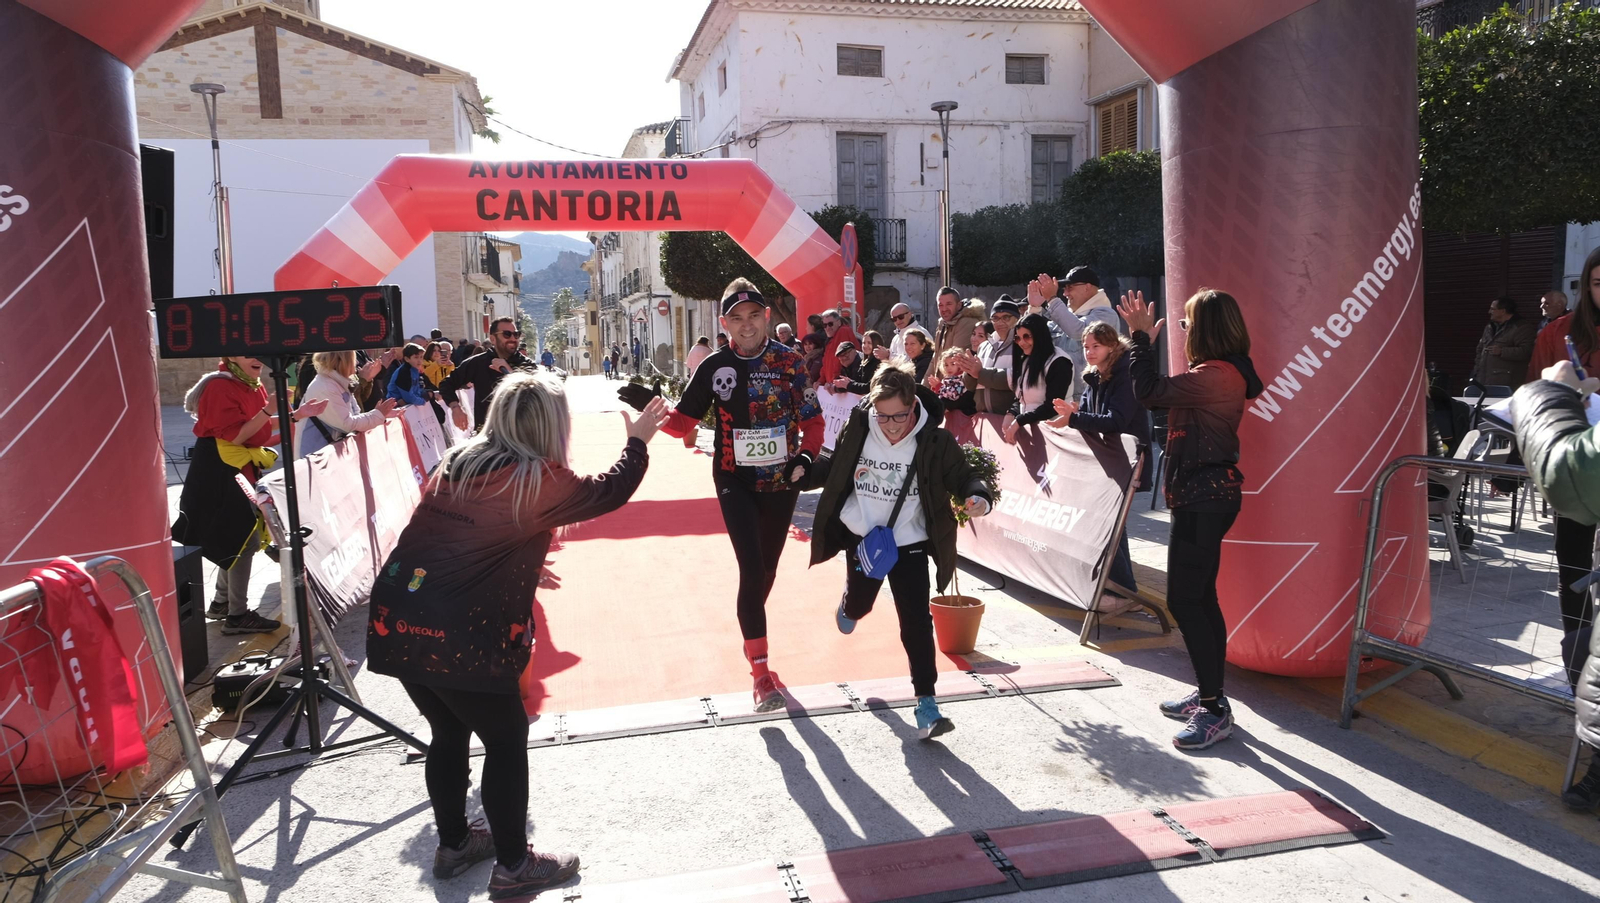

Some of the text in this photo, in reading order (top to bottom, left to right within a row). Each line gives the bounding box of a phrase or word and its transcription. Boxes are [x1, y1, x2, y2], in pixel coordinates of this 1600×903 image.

[468, 161, 688, 180] AYUNTAMIENTO
[476, 188, 682, 221] CANTORIA
[1248, 182, 1422, 423] www.teamergy.es
[166, 292, 387, 352] 87:05.25
[745, 440, 778, 457] 230
[858, 456, 902, 472] EXPLORE
[856, 481, 920, 497] WILD WOLD
[995, 489, 1087, 534] TEAMERGY
[408, 625, 446, 638] VEOLIA
